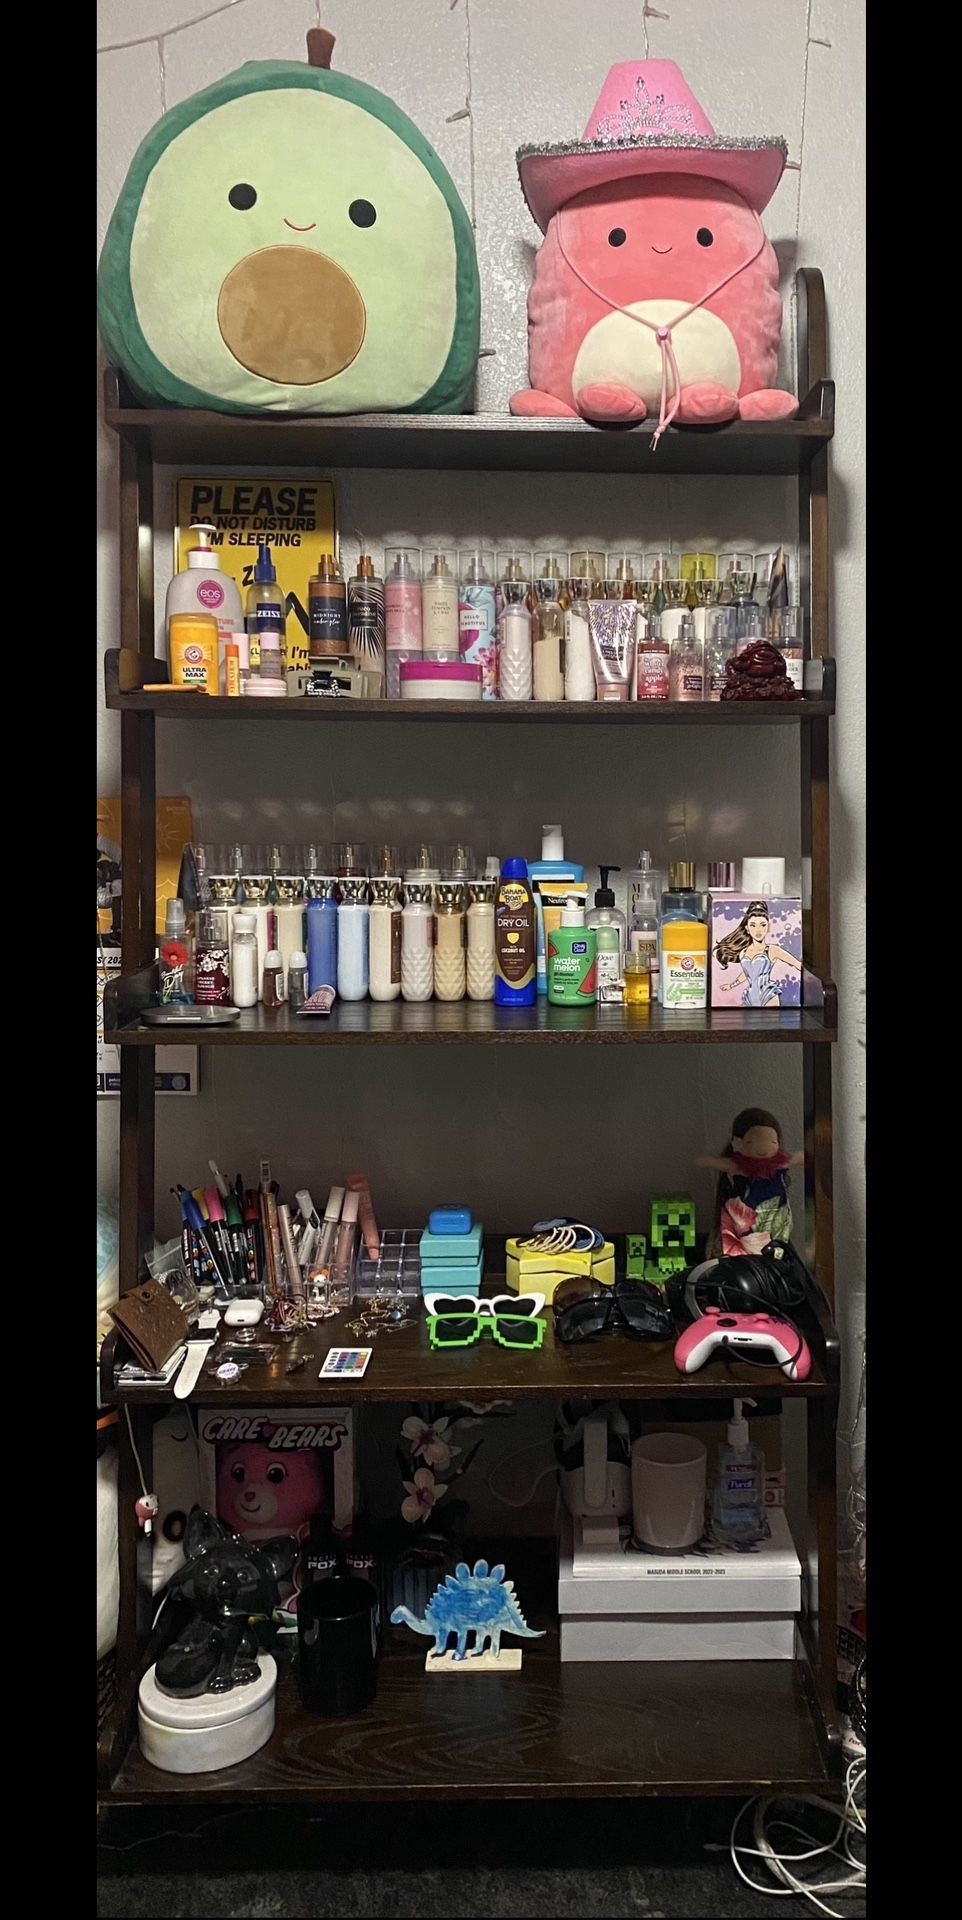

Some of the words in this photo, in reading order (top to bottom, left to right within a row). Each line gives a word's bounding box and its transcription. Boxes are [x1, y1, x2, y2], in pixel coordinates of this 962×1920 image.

[190, 486, 318, 516] PLEASE
[217, 516, 249, 530] NOT
[253, 517, 316, 531] DISTURB
[207, 532, 224, 546] 'M
[229, 533, 301, 547] SLEEPING
[200, 589, 221, 599] eos
[501, 886, 526, 895] BANANA
[505, 894, 521, 903] BOAT
[497, 918, 515, 927] DRY
[515, 918, 529, 927] OIL
[639, 943, 656, 951] SPA
[554, 957, 581, 965] water
[554, 964, 580, 972] melon
[670, 969, 704, 978] Essentials
[203, 1417, 269, 1441] CARE
[268, 1425, 346, 1449] BEARS
[307, 1560, 337, 1570] FOX
[346, 1559, 375, 1568] FOX
